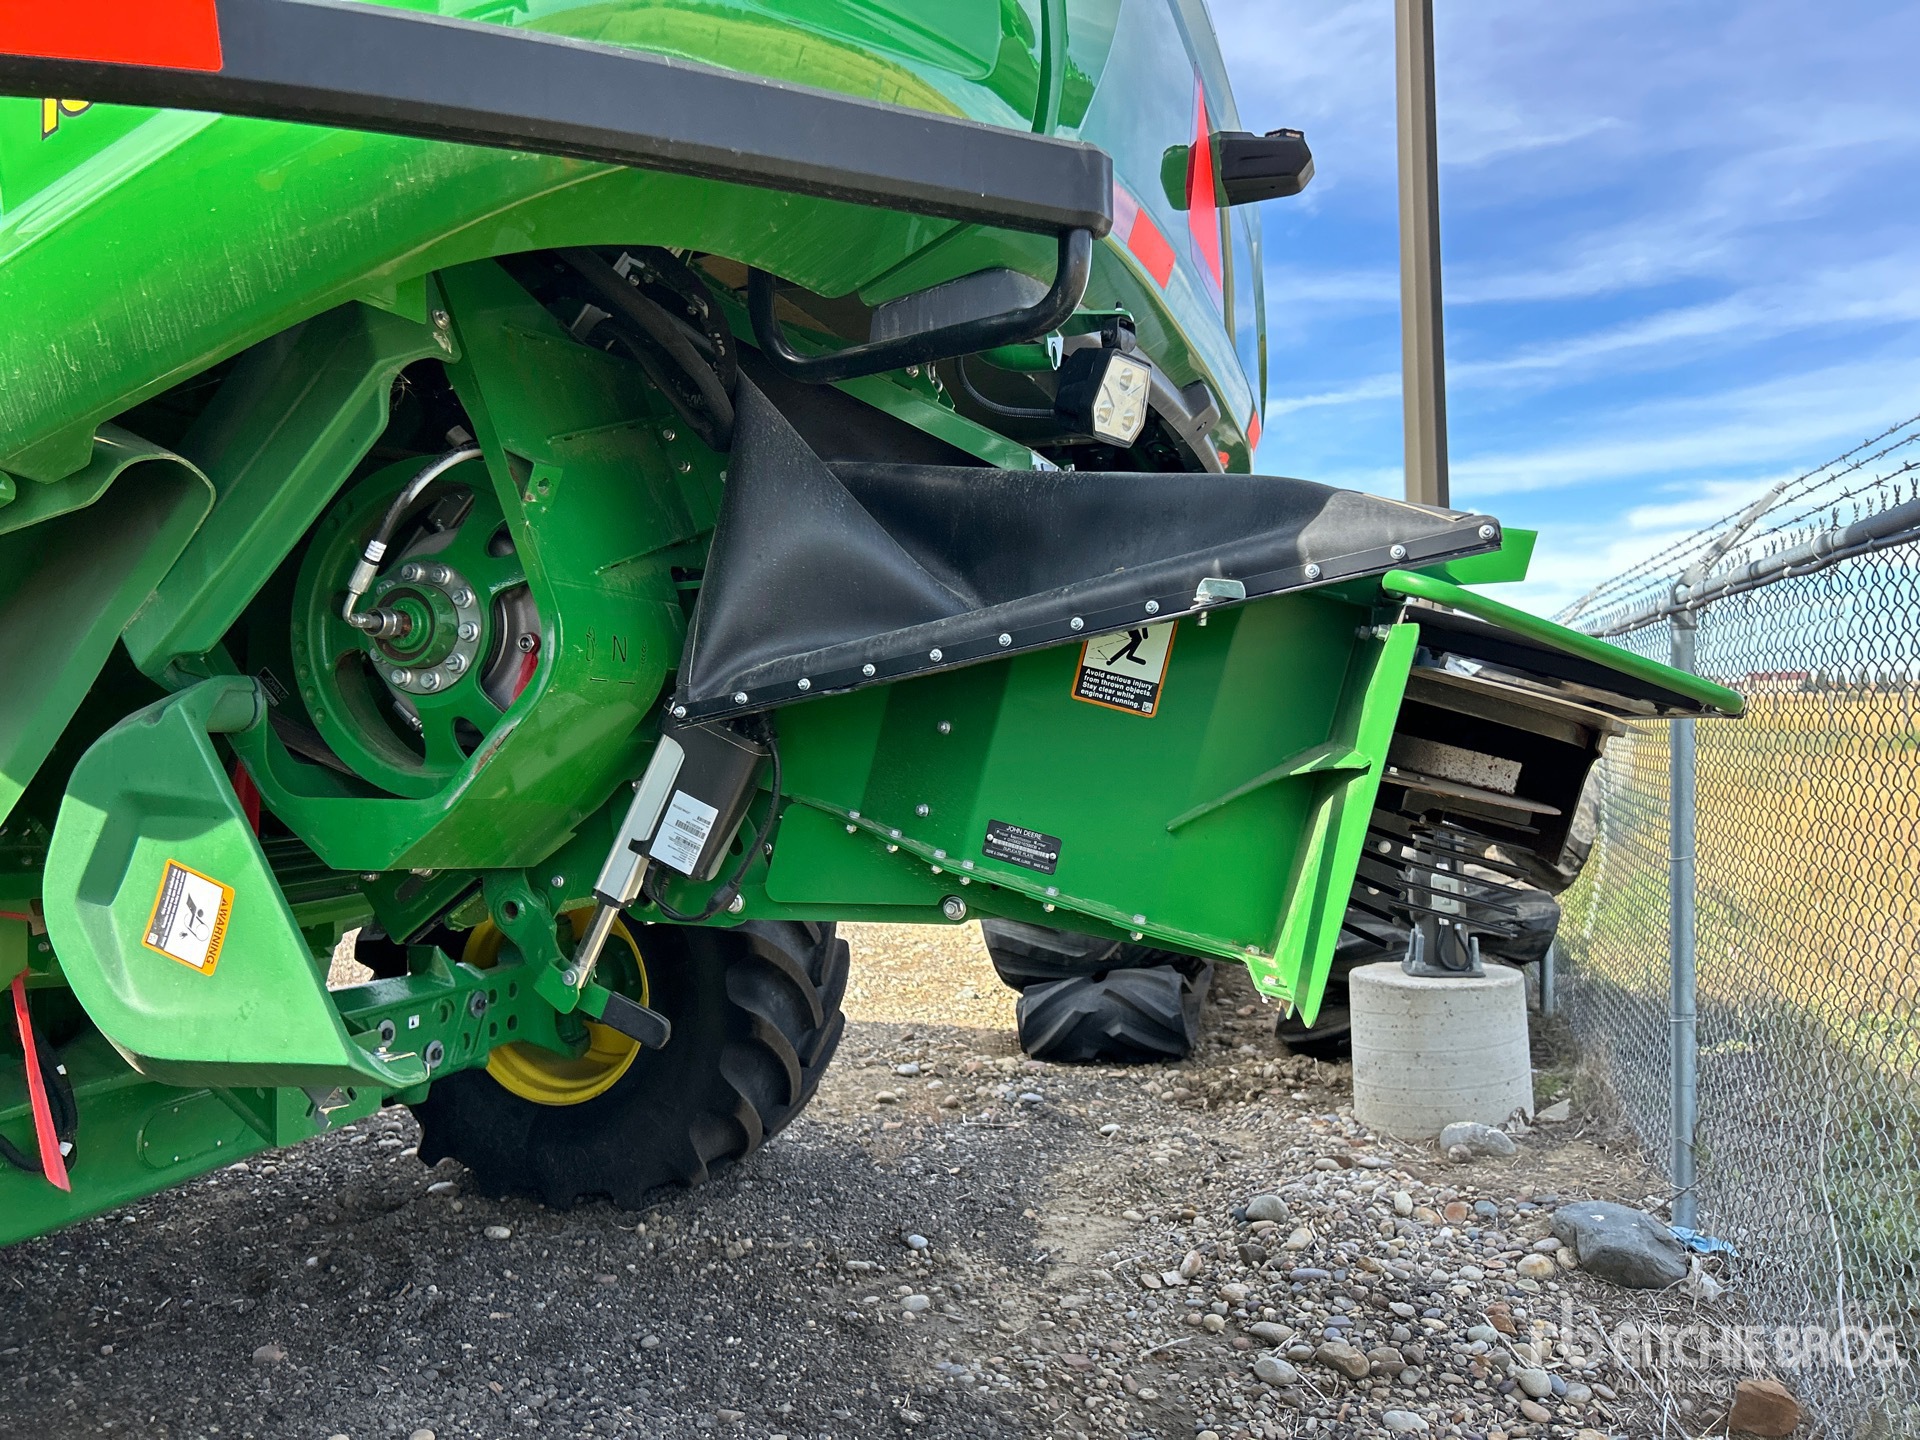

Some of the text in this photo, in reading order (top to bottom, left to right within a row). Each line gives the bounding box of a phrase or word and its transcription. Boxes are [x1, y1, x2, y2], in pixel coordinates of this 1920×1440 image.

[1084, 675, 1152, 696] from thrown objects.
[1086, 669, 1152, 690] Avoid serious injury
[1081, 689, 1103, 698] engine
[1112, 697, 1140, 708] running.
[1083, 681, 1134, 699] Stay clear while
[1007, 826, 1042, 840] JOHN DEERE
[206, 909, 228, 964] WARNING
